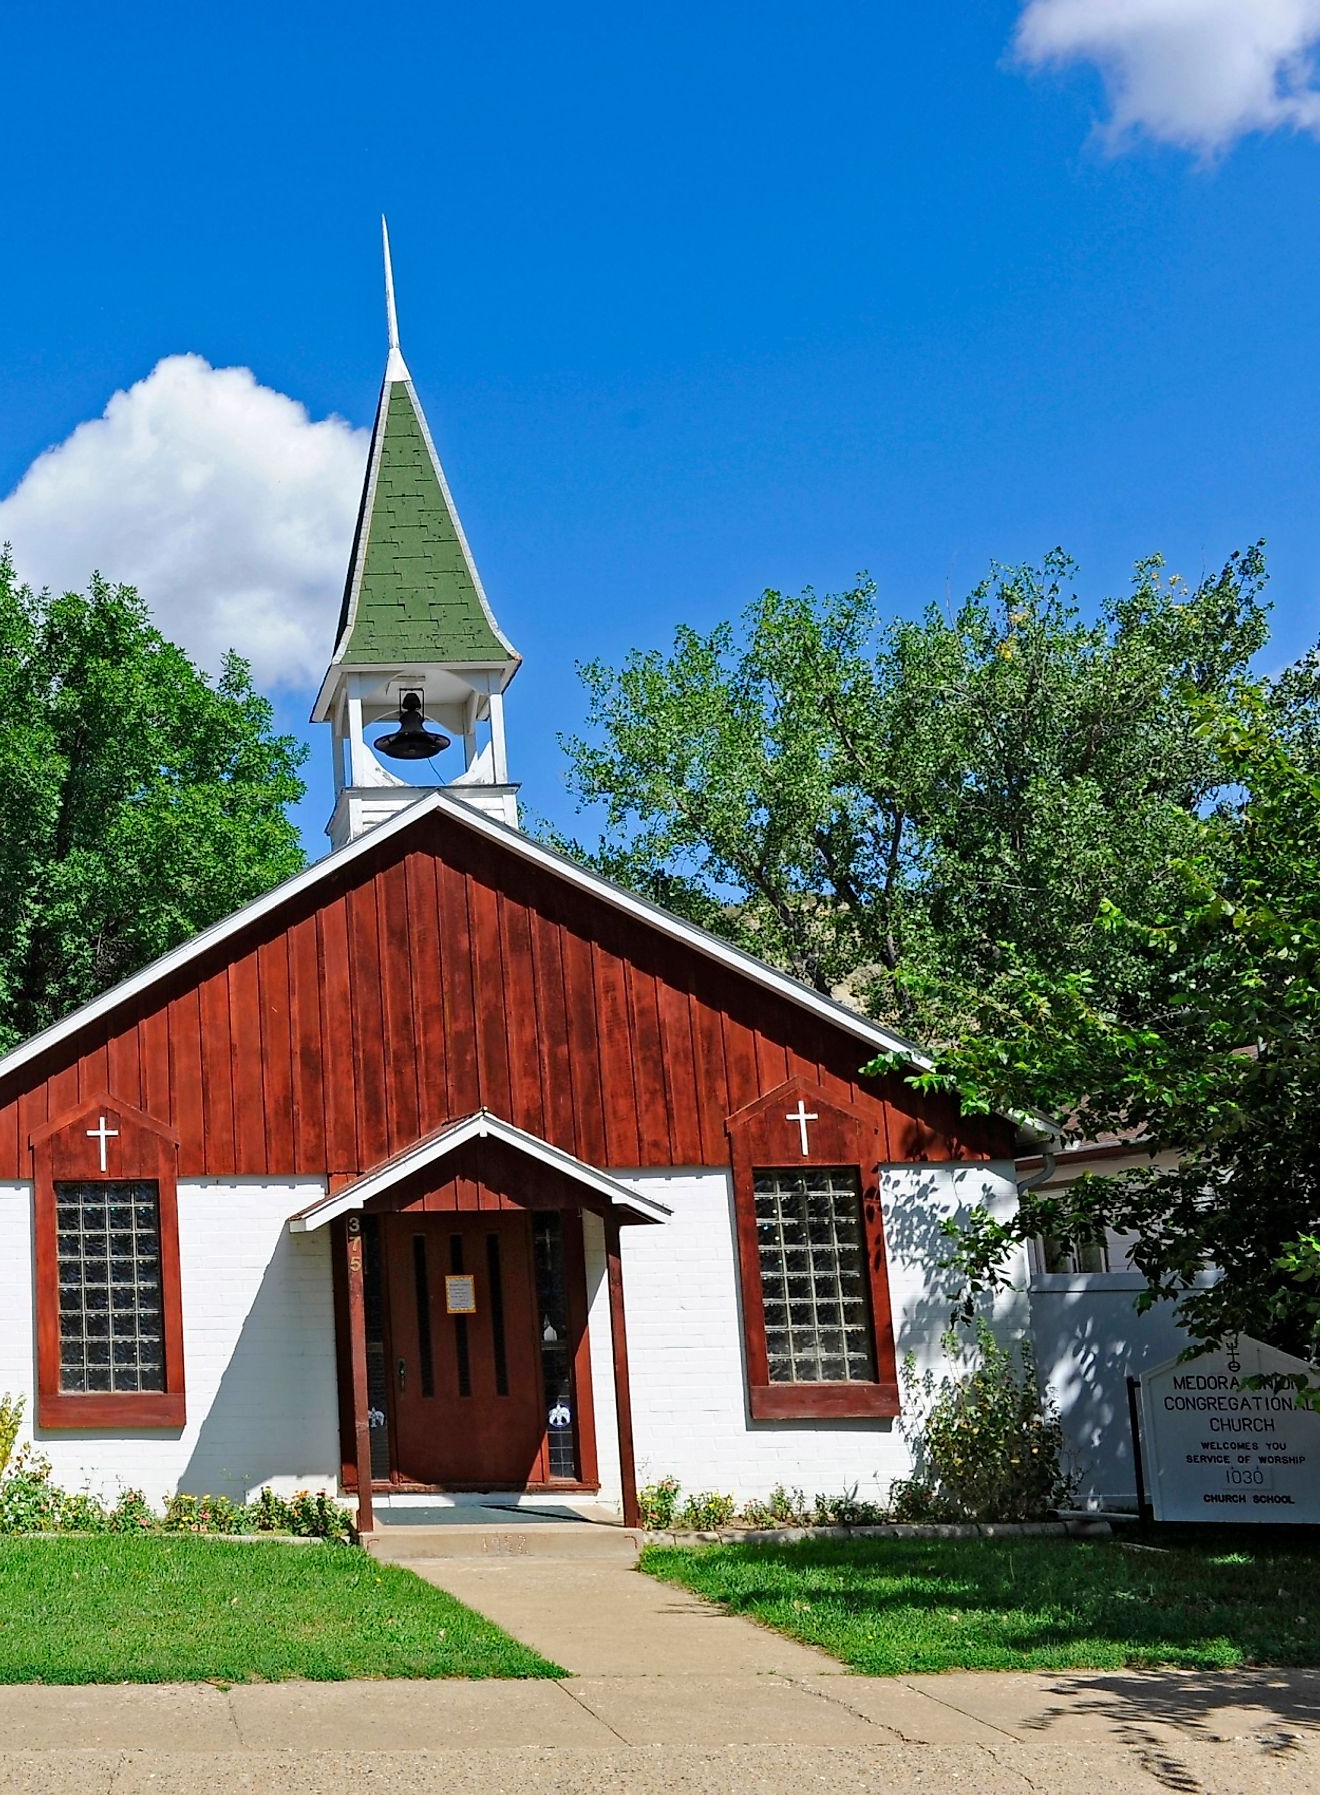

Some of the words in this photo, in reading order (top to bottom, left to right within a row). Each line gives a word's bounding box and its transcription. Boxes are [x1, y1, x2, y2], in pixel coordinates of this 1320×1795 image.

[348, 1217, 361, 1271] 375
[1173, 1375, 1240, 1391] MEDORA
[1164, 1396, 1316, 1411] CONGREGATIONL
[1210, 1417, 1275, 1432] CHURCH
[1201, 1441, 1259, 1451] WELCOMES
[1266, 1442, 1287, 1451] YOU
[1186, 1455, 1230, 1464] SERVICE
[1237, 1455, 1251, 1464] OF
[1258, 1455, 1306, 1465] WORSHIP
[1203, 1494, 1246, 1504] CHURCH
[1253, 1494, 1296, 1504] SCHOOL
